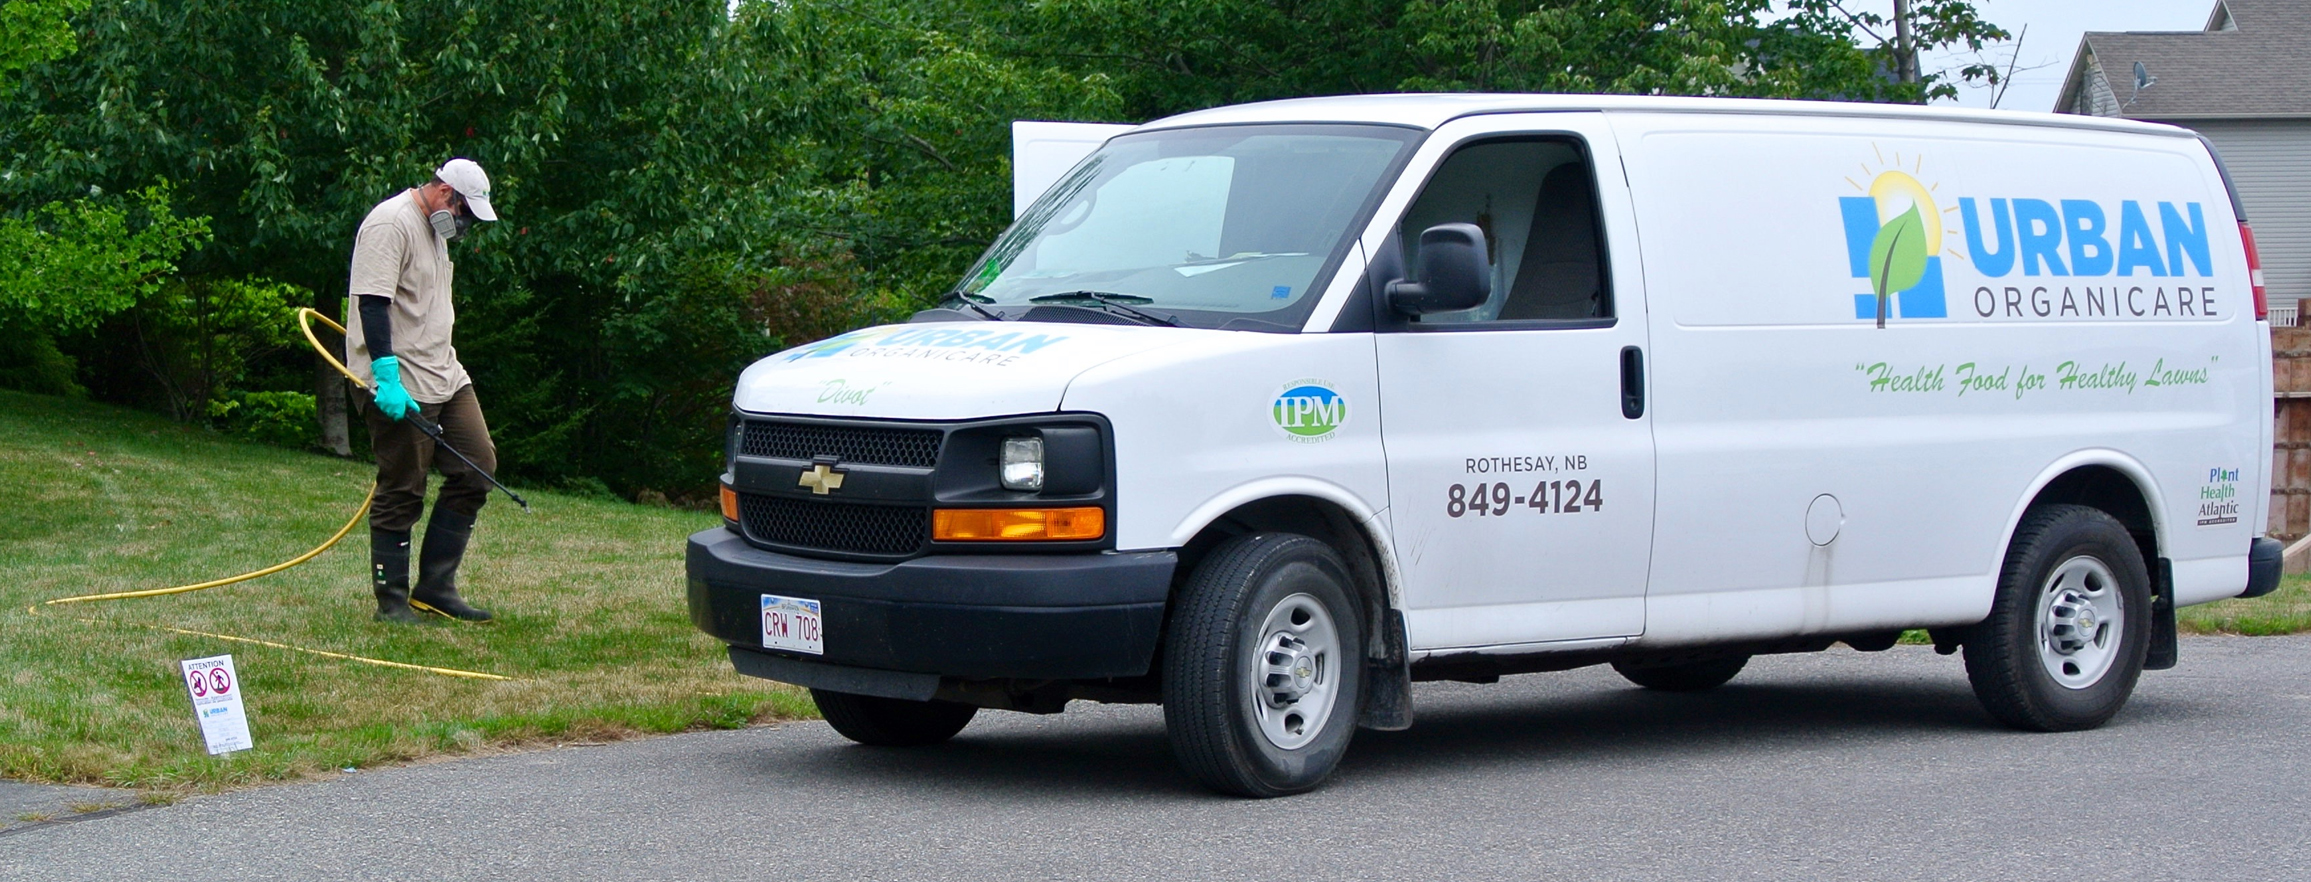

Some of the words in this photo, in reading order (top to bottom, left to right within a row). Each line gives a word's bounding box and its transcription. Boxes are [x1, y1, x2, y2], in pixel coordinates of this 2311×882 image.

[1958, 196, 2213, 278] URBAN
[1974, 286, 2218, 318] ORGANICARE
[876, 329, 1068, 354] URBAN
[850, 348, 1019, 366] ORGANICARE
[1955, 361, 2010, 397] Food
[2016, 364, 2046, 400] for
[2057, 360, 2137, 395] Healthy
[1279, 395, 1340, 428] IPM
[1286, 431, 1335, 444] ACCREDITED
[1465, 456, 1559, 474] ROTHESAY,
[1564, 455, 1588, 471] NB
[1446, 479, 1604, 518] 849-4124
[2200, 483, 2235, 502] Health
[2198, 500, 2239, 518] Atlantic
[765, 611, 788, 638] CRW
[795, 615, 818, 641] 708
[188, 660, 224, 670] ATTENTION
